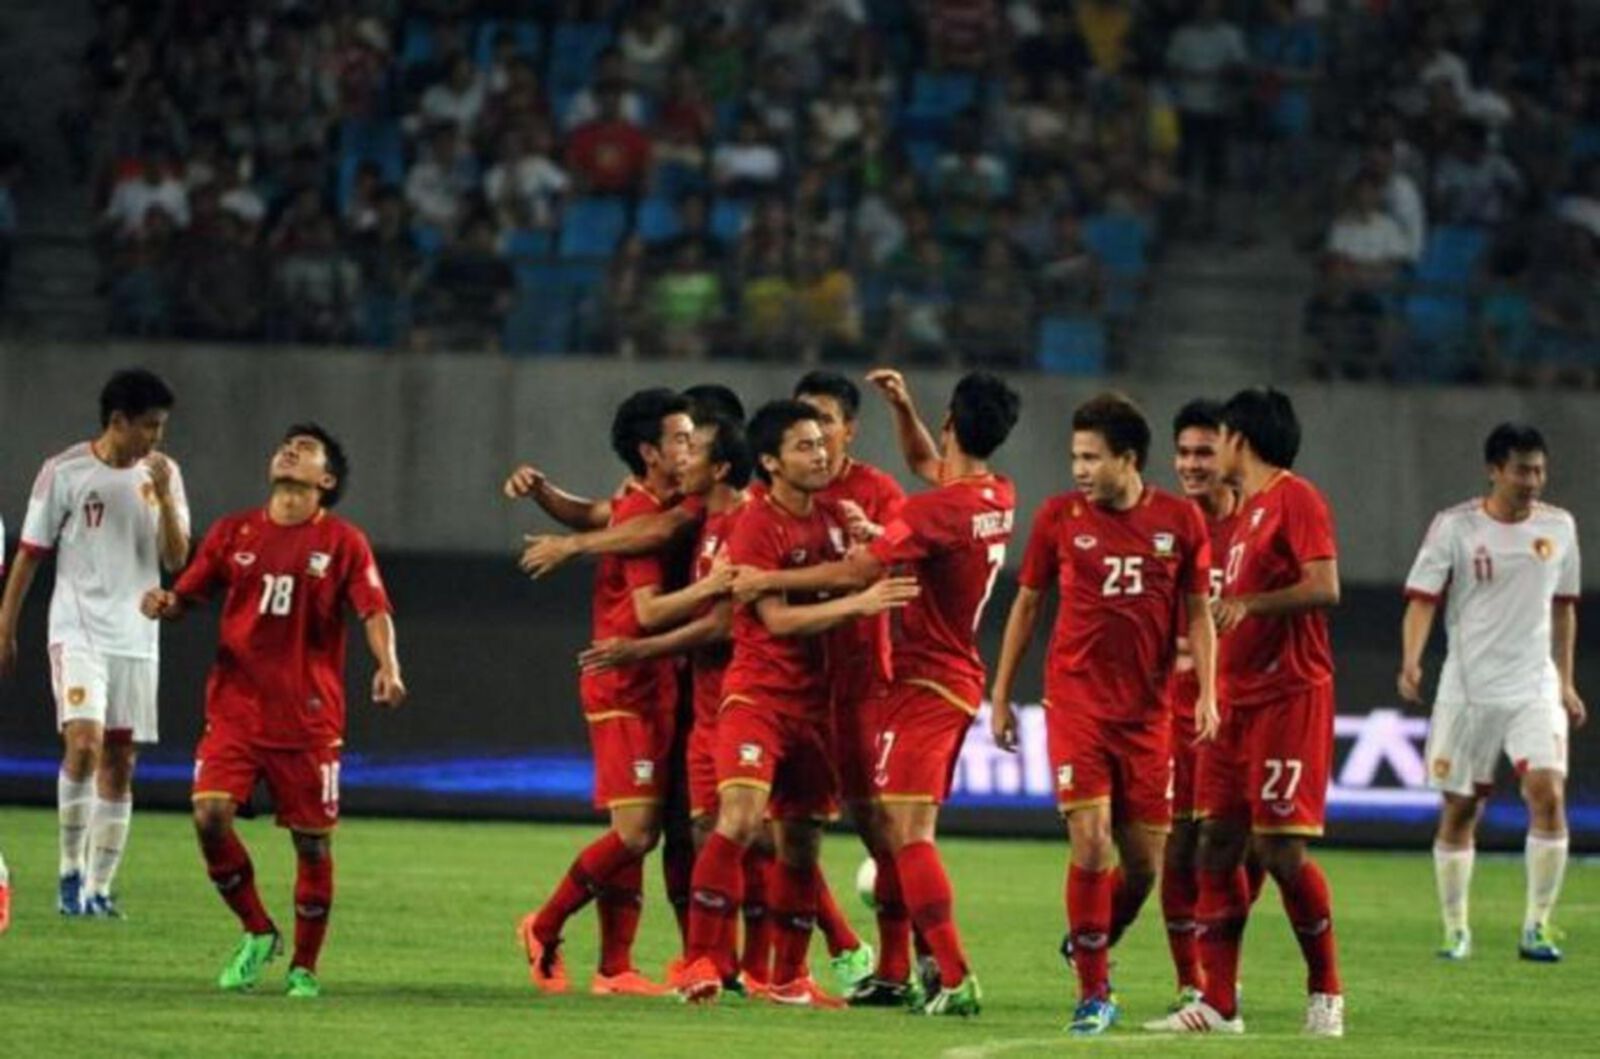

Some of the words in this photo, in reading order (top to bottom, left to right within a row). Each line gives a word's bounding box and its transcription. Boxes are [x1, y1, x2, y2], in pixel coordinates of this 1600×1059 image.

[84, 502, 105, 528] 17
[974, 543, 1006, 632] 7
[1102, 556, 1144, 597] 25
[1474, 557, 1493, 582] 11
[259, 573, 295, 616] 18
[1260, 759, 1303, 800] 27
